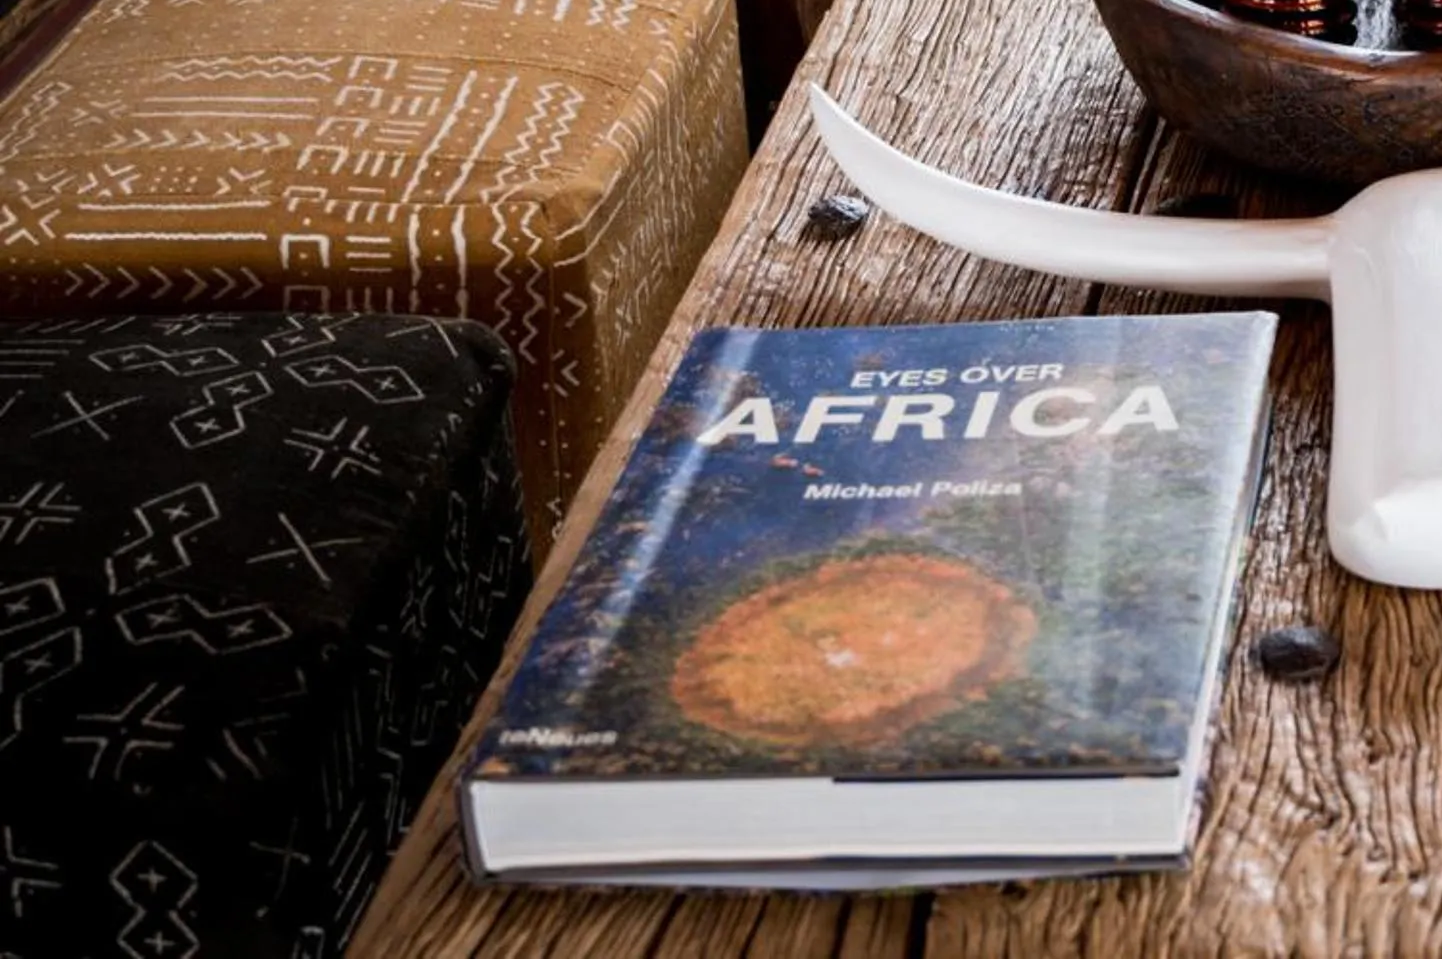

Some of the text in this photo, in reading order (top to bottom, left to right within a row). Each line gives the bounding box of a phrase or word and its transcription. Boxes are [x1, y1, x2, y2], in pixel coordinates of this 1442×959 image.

[850, 363, 1065, 388] EYES OVER
[695, 385, 1180, 446] AFRICA
[803, 480, 1023, 500] Michael Poliza
